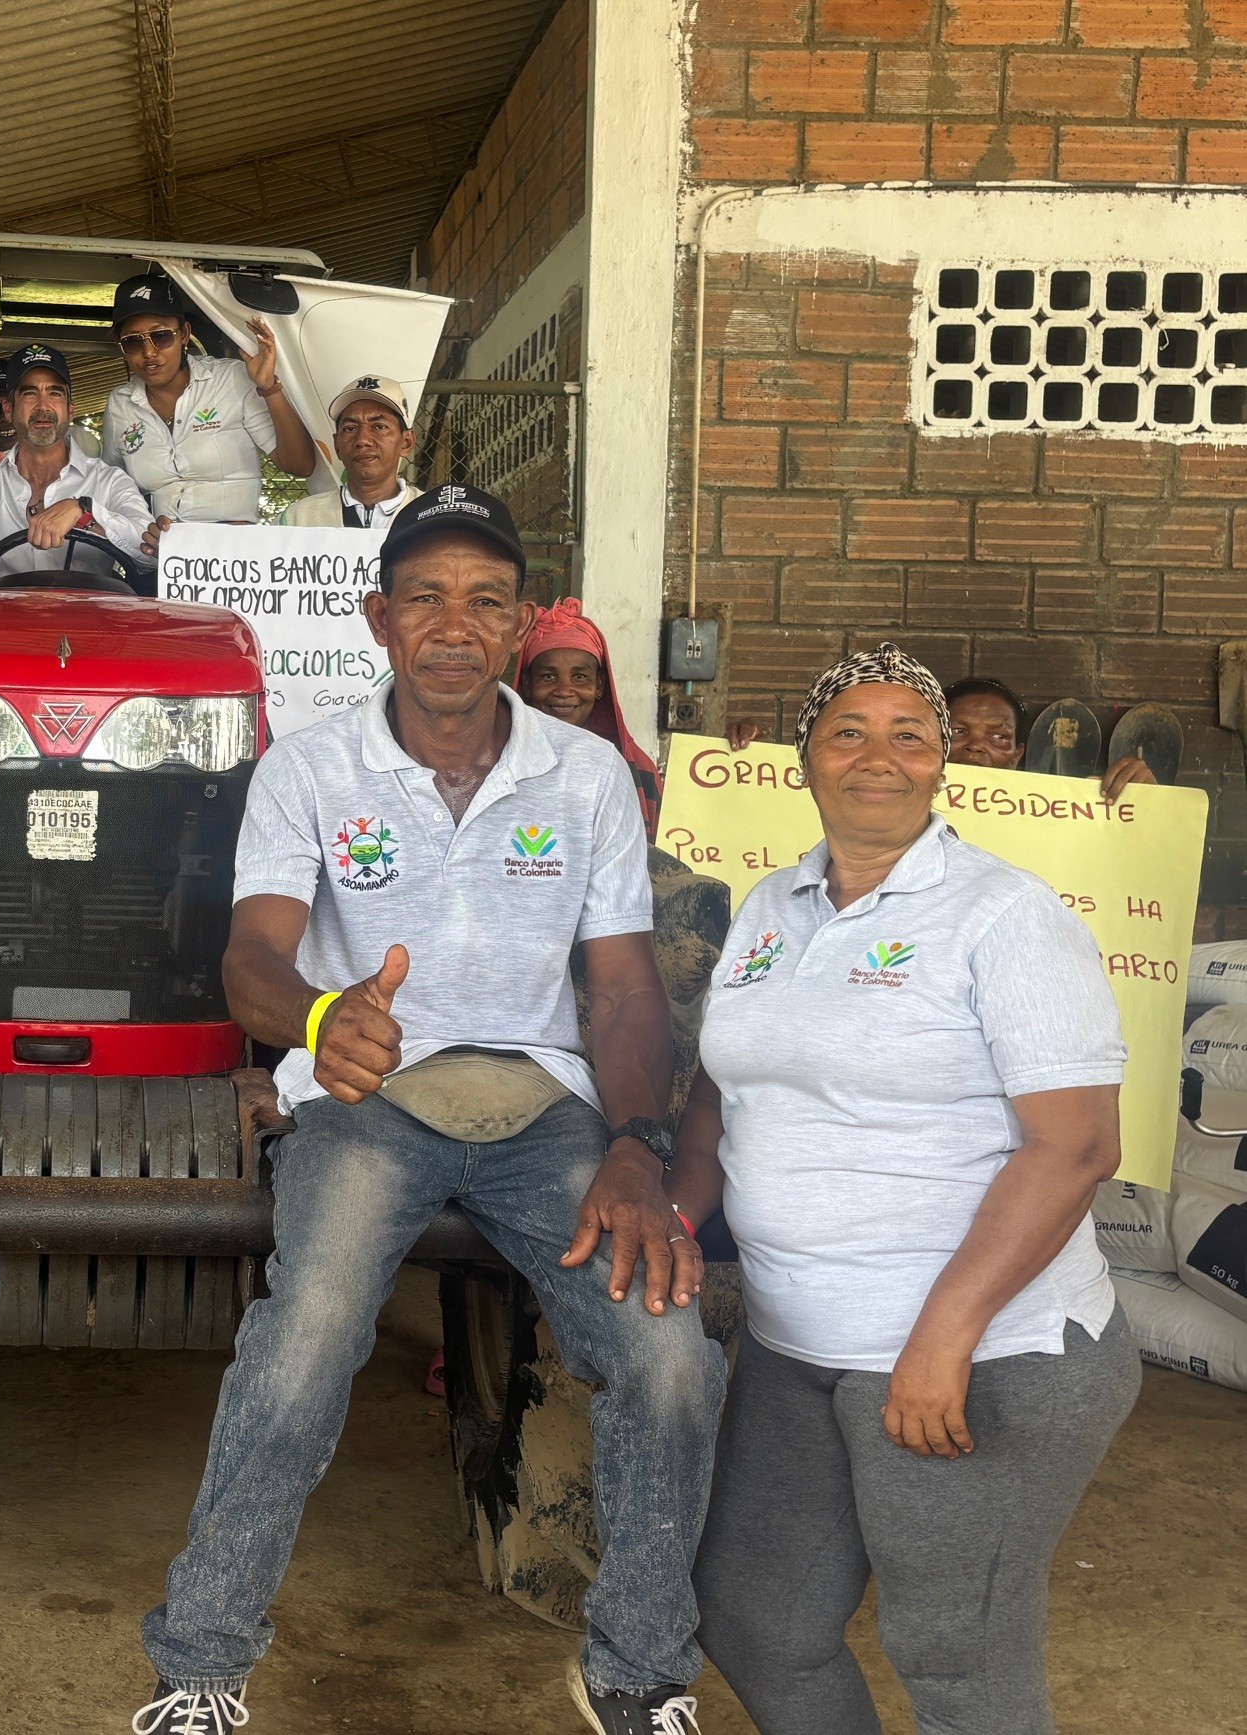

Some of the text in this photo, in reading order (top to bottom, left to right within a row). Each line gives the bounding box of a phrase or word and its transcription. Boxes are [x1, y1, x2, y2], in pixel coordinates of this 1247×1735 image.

[163, 555, 261, 584] Gracias
[270, 554, 348, 586] BANCO
[27, 811, 91, 828] 010195
[504, 857, 564, 870] Banco Agrario
[506, 867, 562, 877] de Colombia
[337, 869, 400, 892] ASOAMIAMPRO
[1127, 896, 1163, 922] HA
[850, 968, 910, 980] Banco Agrario
[1098, 951, 1178, 985] ARIO
[847, 976, 903, 988] de Colombia
[1211, 1040, 1239, 1050] UREA
[1095, 1221, 1153, 1234] GRANULAR
[1210, 1265, 1240, 1290] 50 kg
